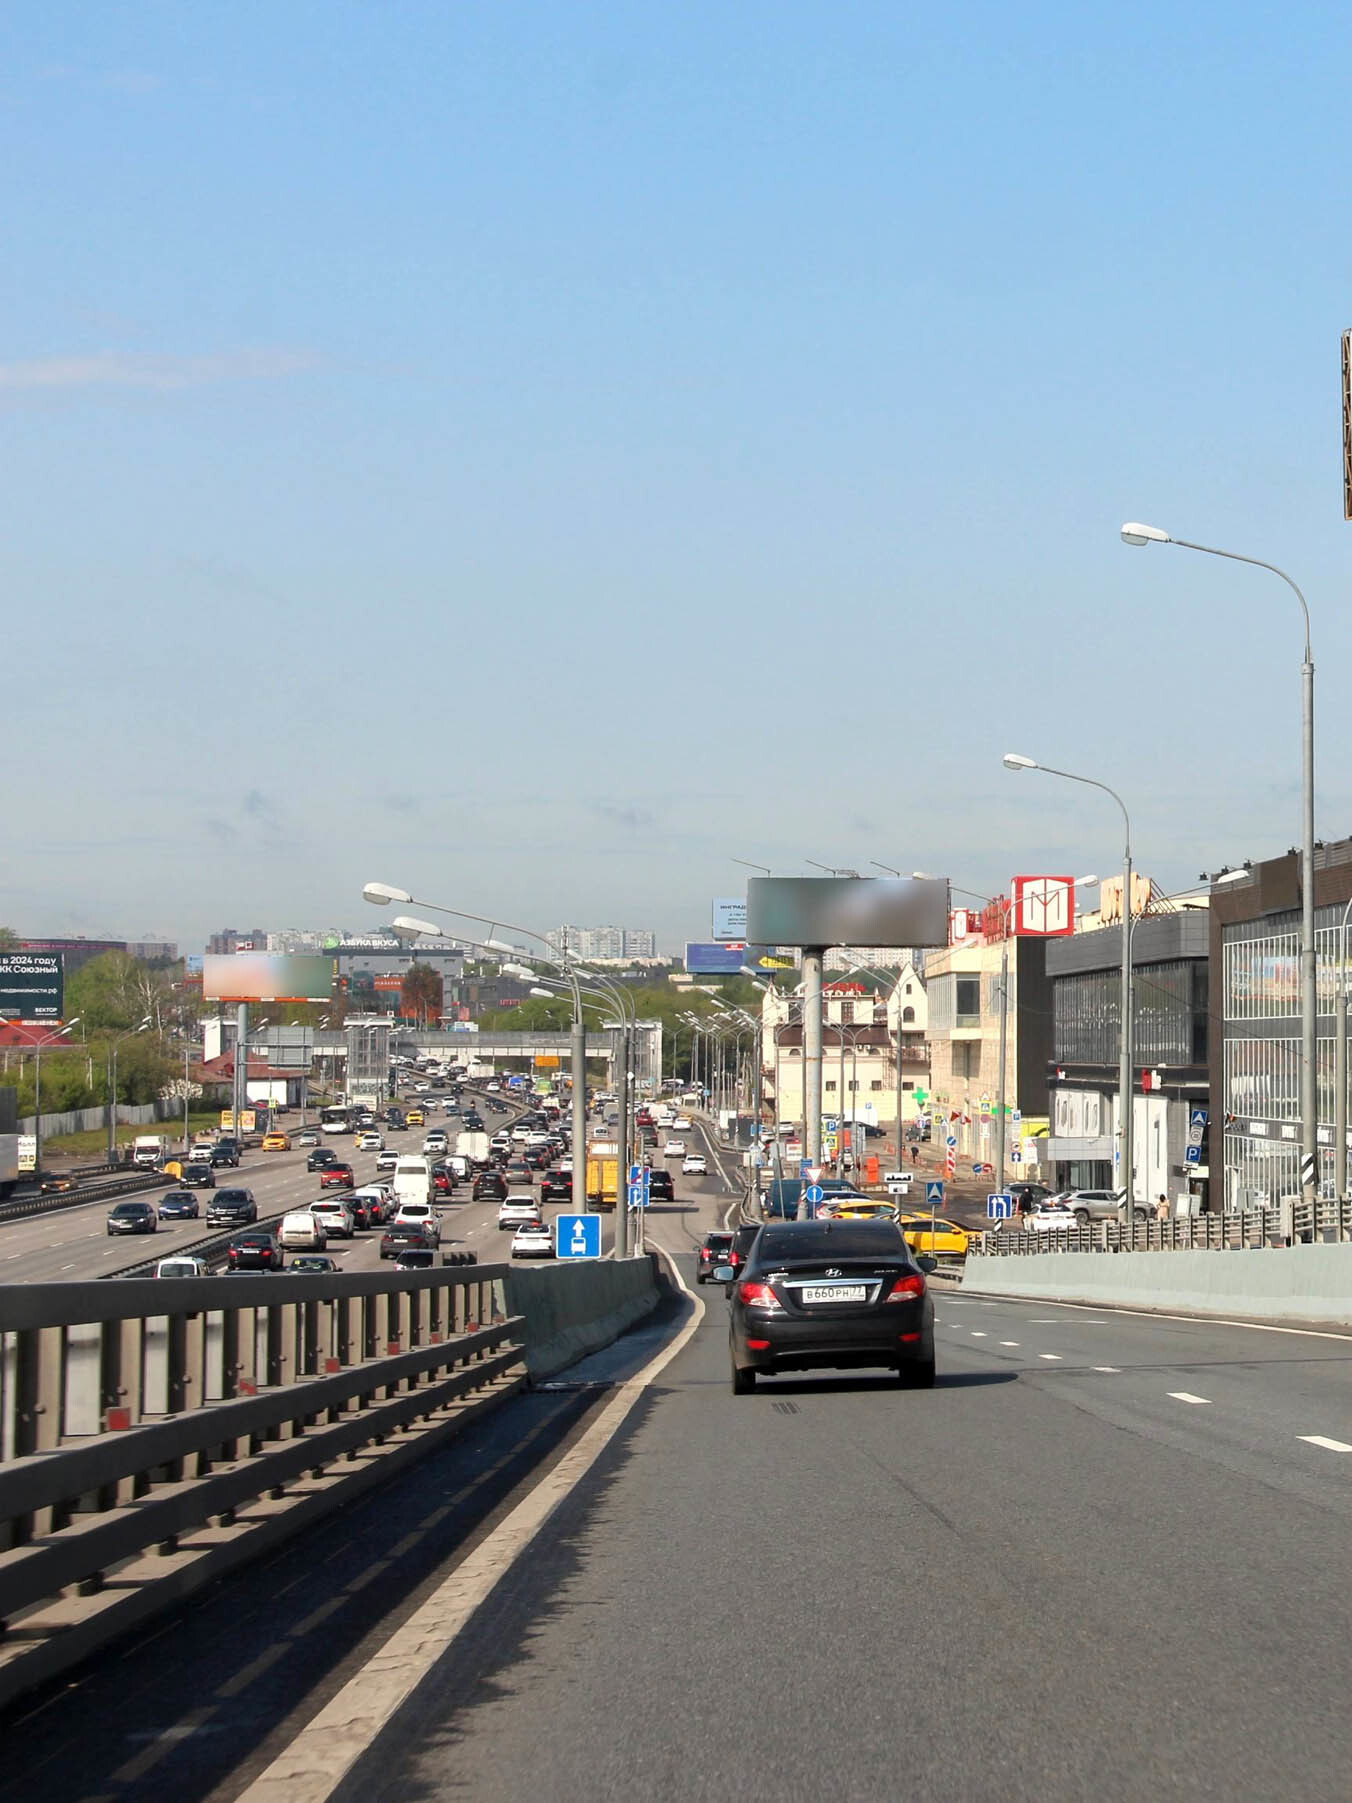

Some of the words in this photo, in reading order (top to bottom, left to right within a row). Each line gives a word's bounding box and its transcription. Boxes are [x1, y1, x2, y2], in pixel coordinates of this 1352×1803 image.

[10, 956, 32, 964] 2024
[34, 957, 57, 966] году
[13, 965, 58, 973] Союзный
